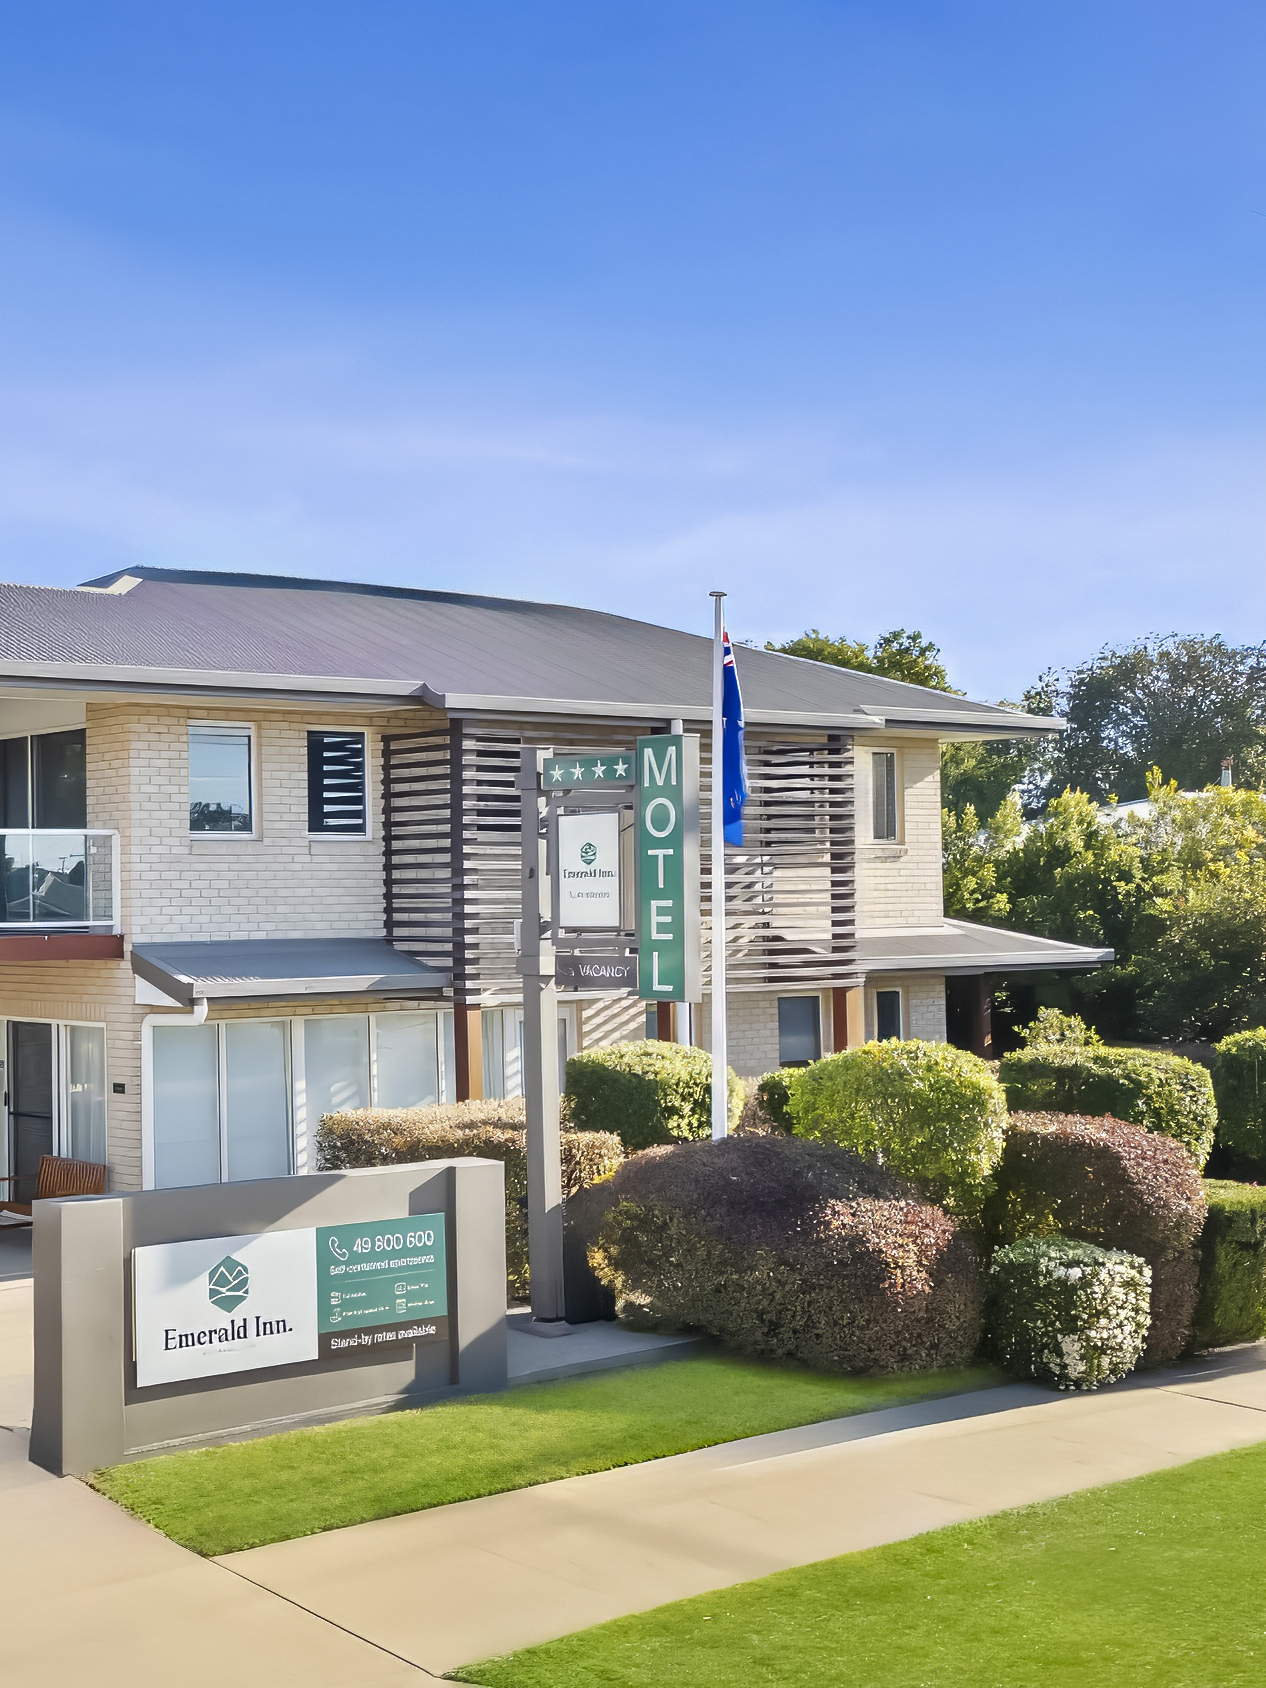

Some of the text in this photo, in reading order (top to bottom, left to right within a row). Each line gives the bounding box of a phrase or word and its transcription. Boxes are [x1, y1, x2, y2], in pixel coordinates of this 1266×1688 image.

[644, 745, 678, 992] MOTEL
[578, 964, 630, 977] VACANCY
[353, 1237, 371, 1253] 49
[406, 1230, 434, 1248] 600
[163, 1315, 294, 1351] Emerald Inn.
